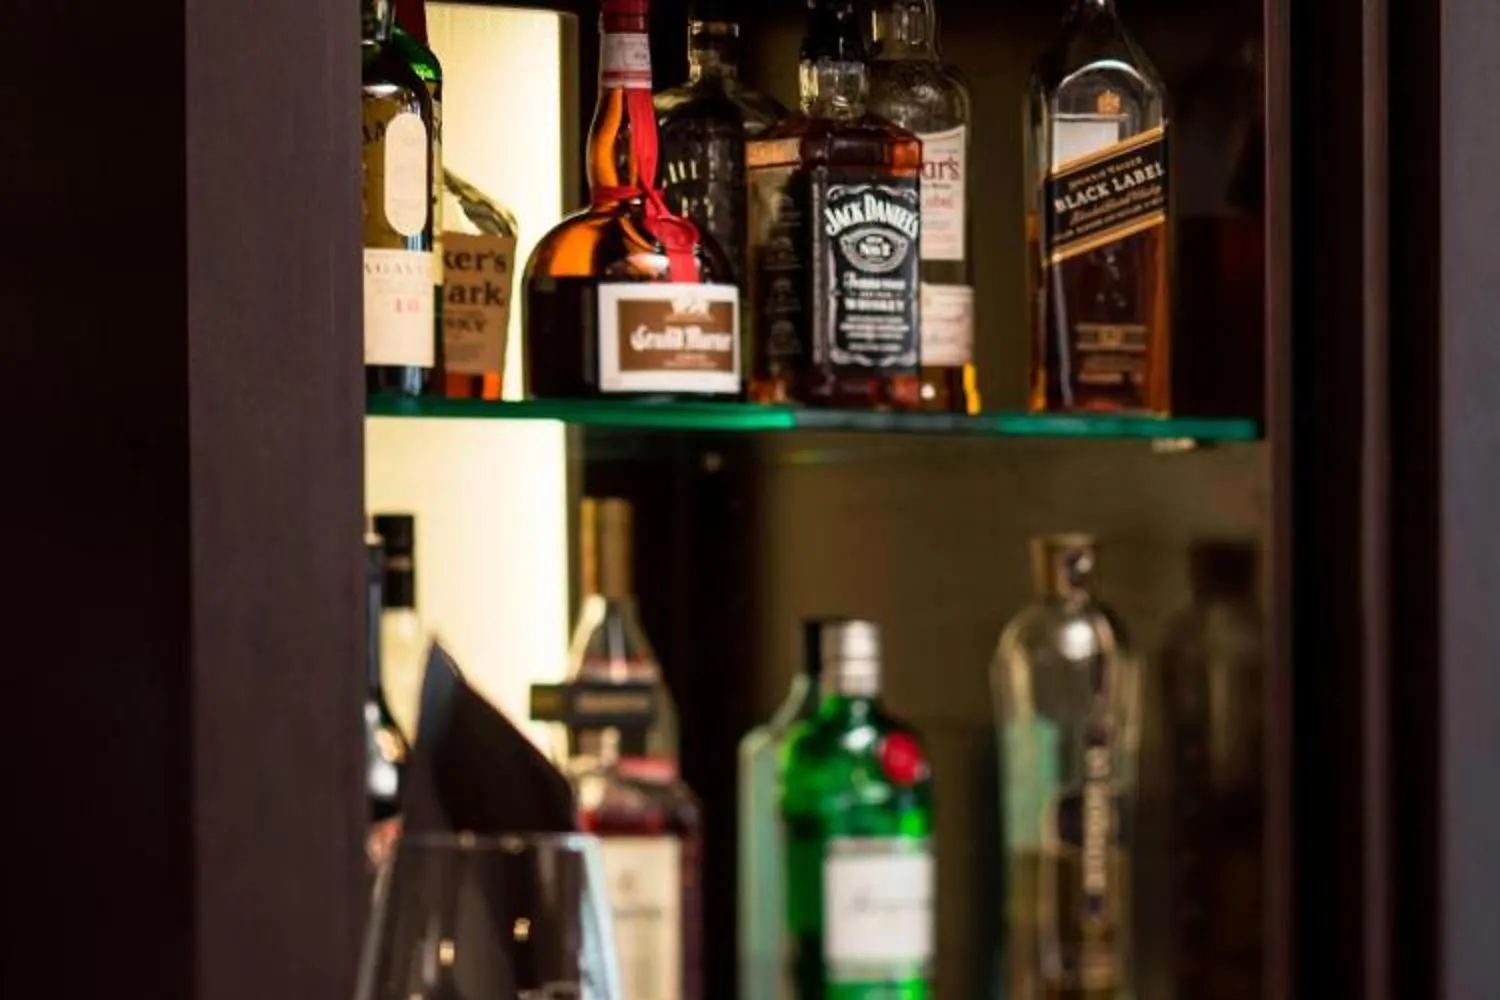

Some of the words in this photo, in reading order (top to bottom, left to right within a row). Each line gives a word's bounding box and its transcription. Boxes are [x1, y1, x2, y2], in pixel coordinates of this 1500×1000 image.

[1053, 181, 1111, 214] BLACK
[1111, 161, 1166, 193] LABEL
[824, 201, 865, 237] JACK
